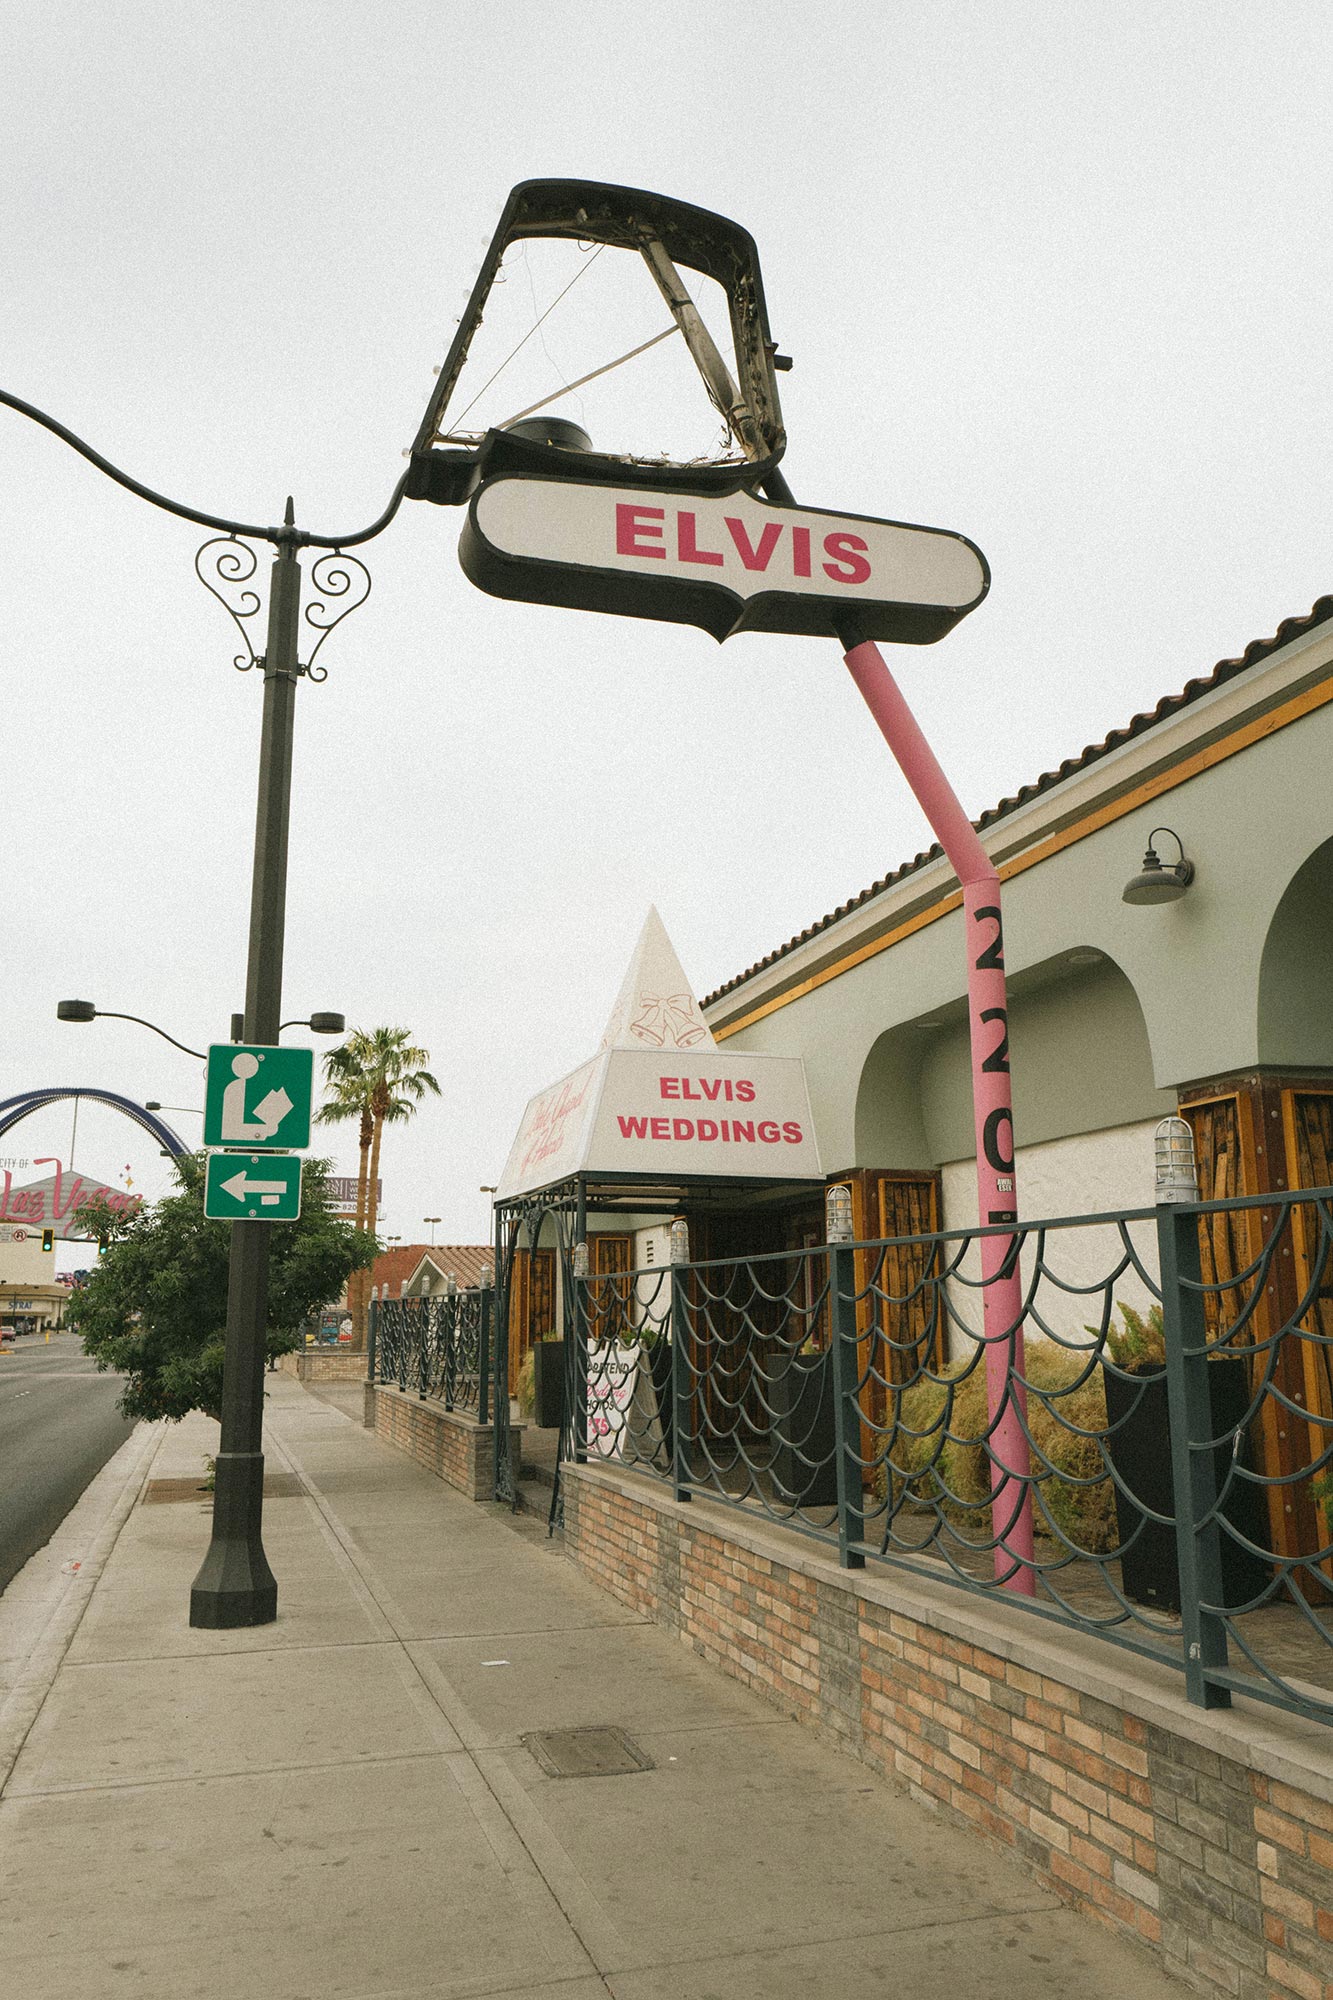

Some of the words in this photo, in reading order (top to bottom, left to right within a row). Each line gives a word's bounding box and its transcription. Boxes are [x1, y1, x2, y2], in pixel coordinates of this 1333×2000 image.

[616, 503, 872, 584] ELVIS
[659, 1077, 756, 1103] ELVIS
[617, 1115, 803, 1145] WEDDINGS
[0, 1158, 16, 1168] CITY
[19, 1158, 29, 1168] OF
[0, 1168, 45, 1223] Las
